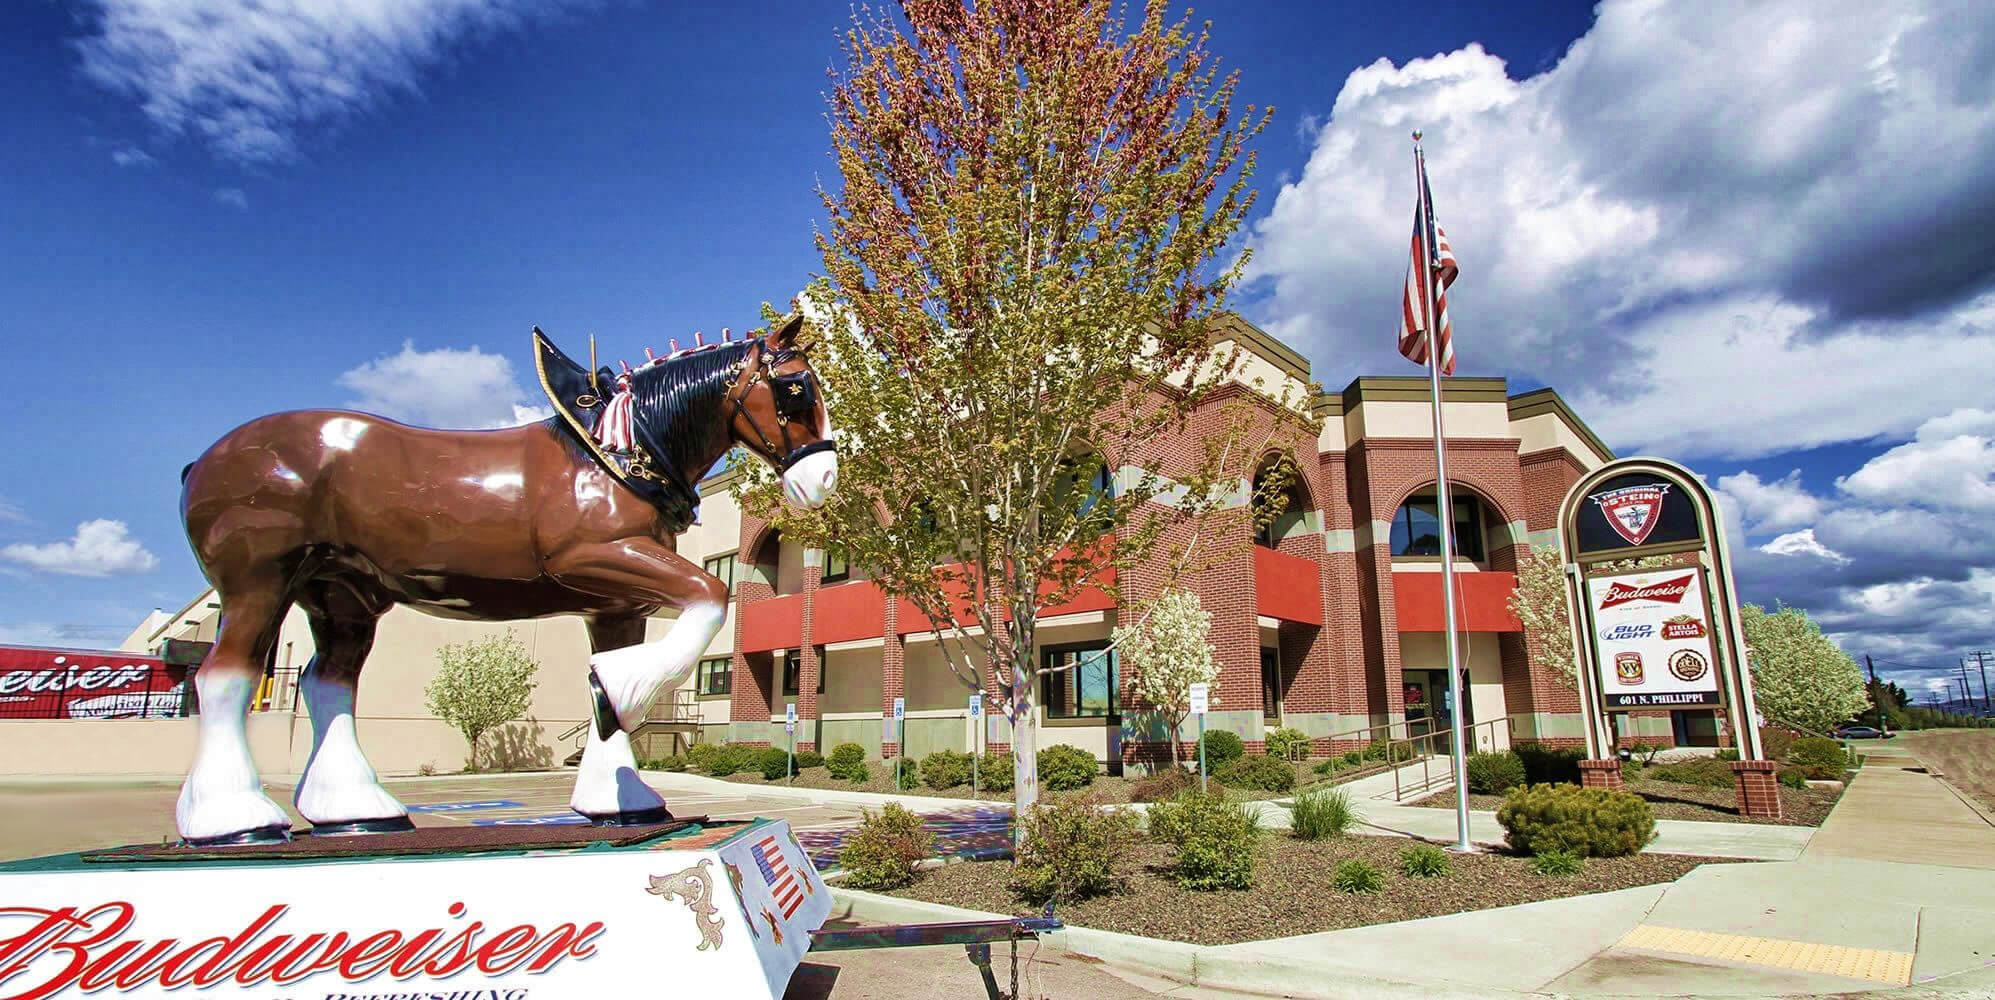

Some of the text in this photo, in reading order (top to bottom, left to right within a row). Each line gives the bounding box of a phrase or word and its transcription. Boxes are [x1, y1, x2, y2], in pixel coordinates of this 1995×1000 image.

[1608, 493, 1654, 506] STEIN
[1599, 583, 1692, 602] Budweiser
[1614, 624, 1652, 633] BUD
[1606, 631, 1656, 641] LIGHT
[1619, 693, 1704, 705] 601 N. PHILLIPPI
[0, 902, 605, 1000] Budweiser
